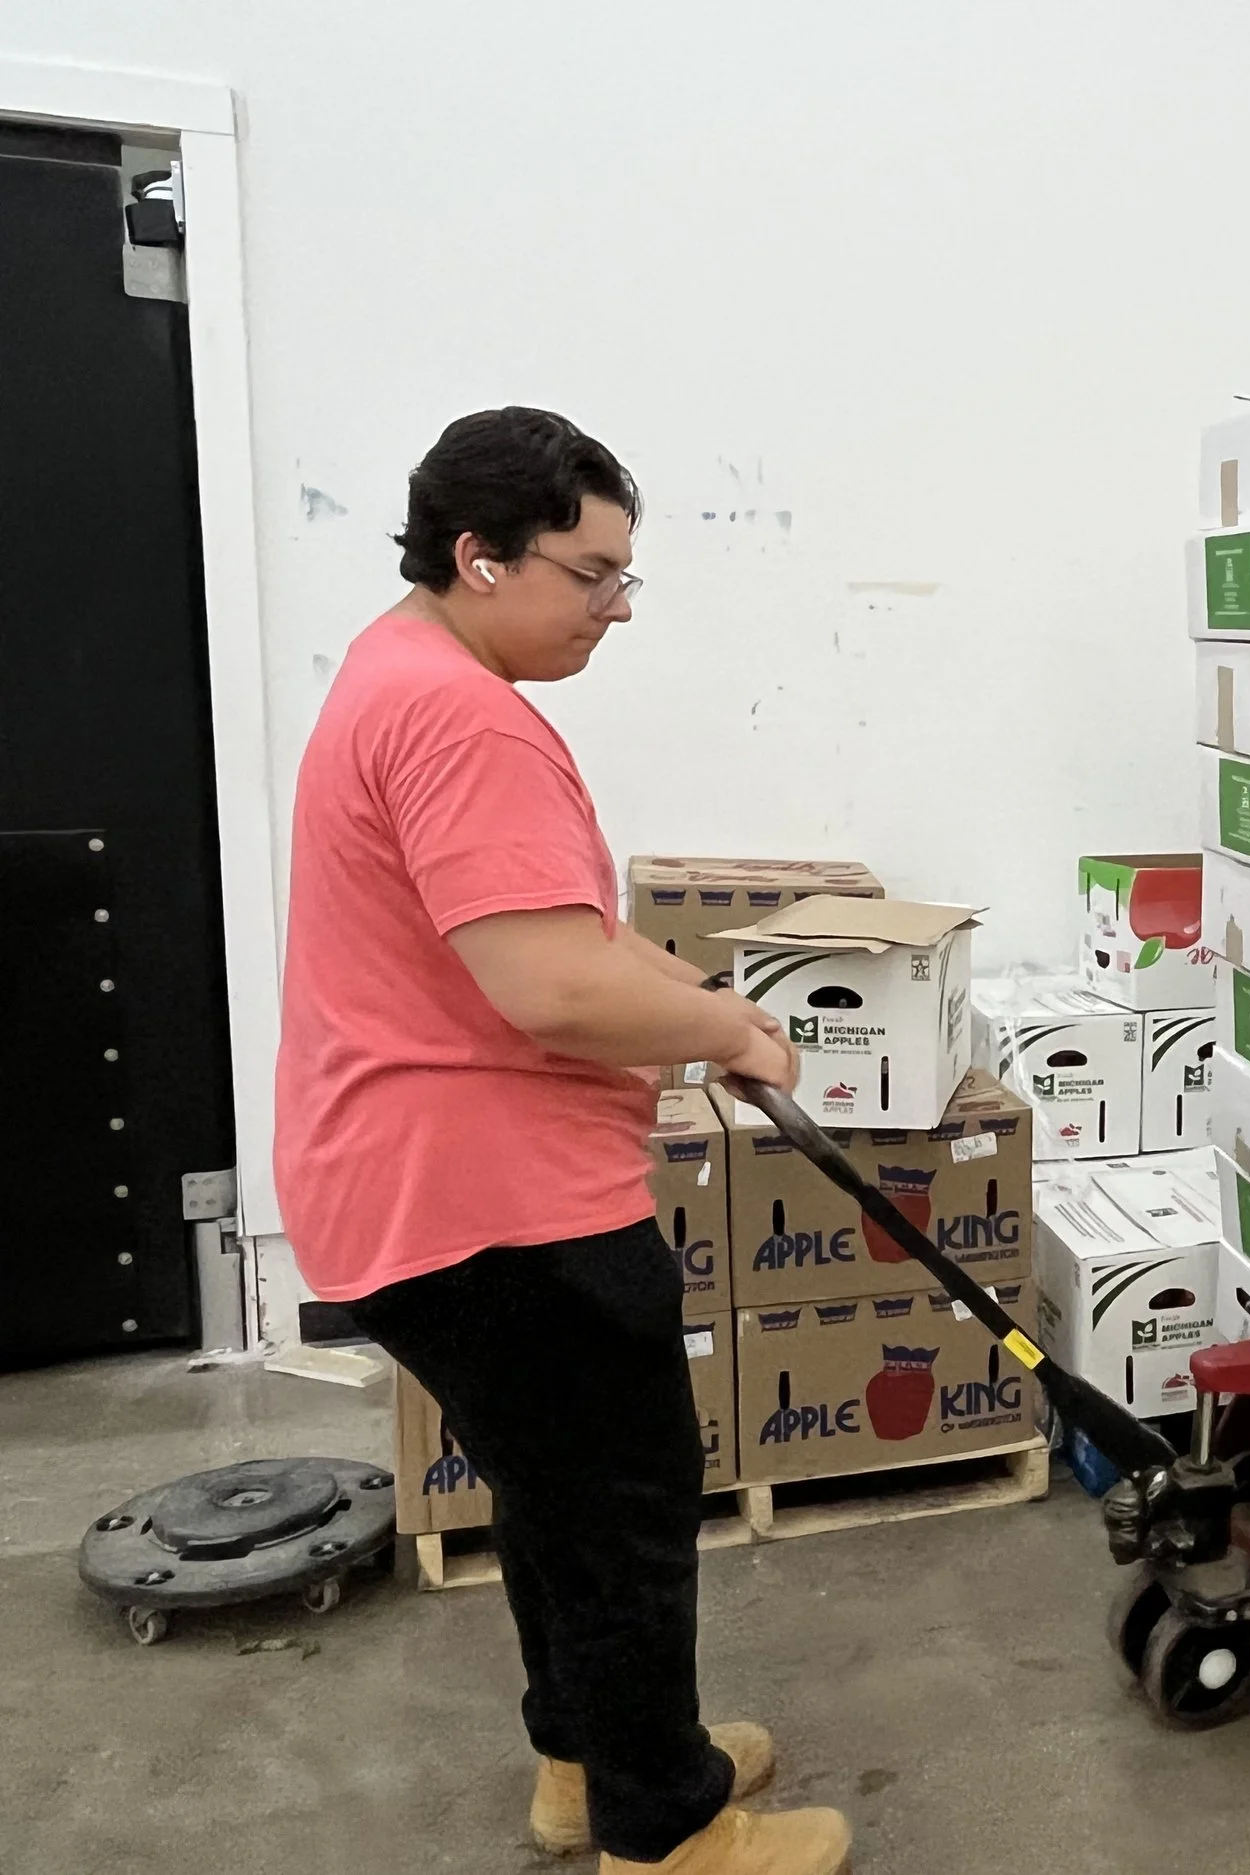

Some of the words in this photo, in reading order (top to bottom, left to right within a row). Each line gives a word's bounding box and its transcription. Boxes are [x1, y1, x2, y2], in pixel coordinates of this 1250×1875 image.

[823, 1025, 886, 1036] MICHIGAN
[823, 1036, 870, 1047] APPLES
[752, 1226, 857, 1272] APPLE
[936, 1209, 1020, 1251] KING
[939, 1375, 1022, 1422] KING
[759, 1398, 861, 1446] APPLE
